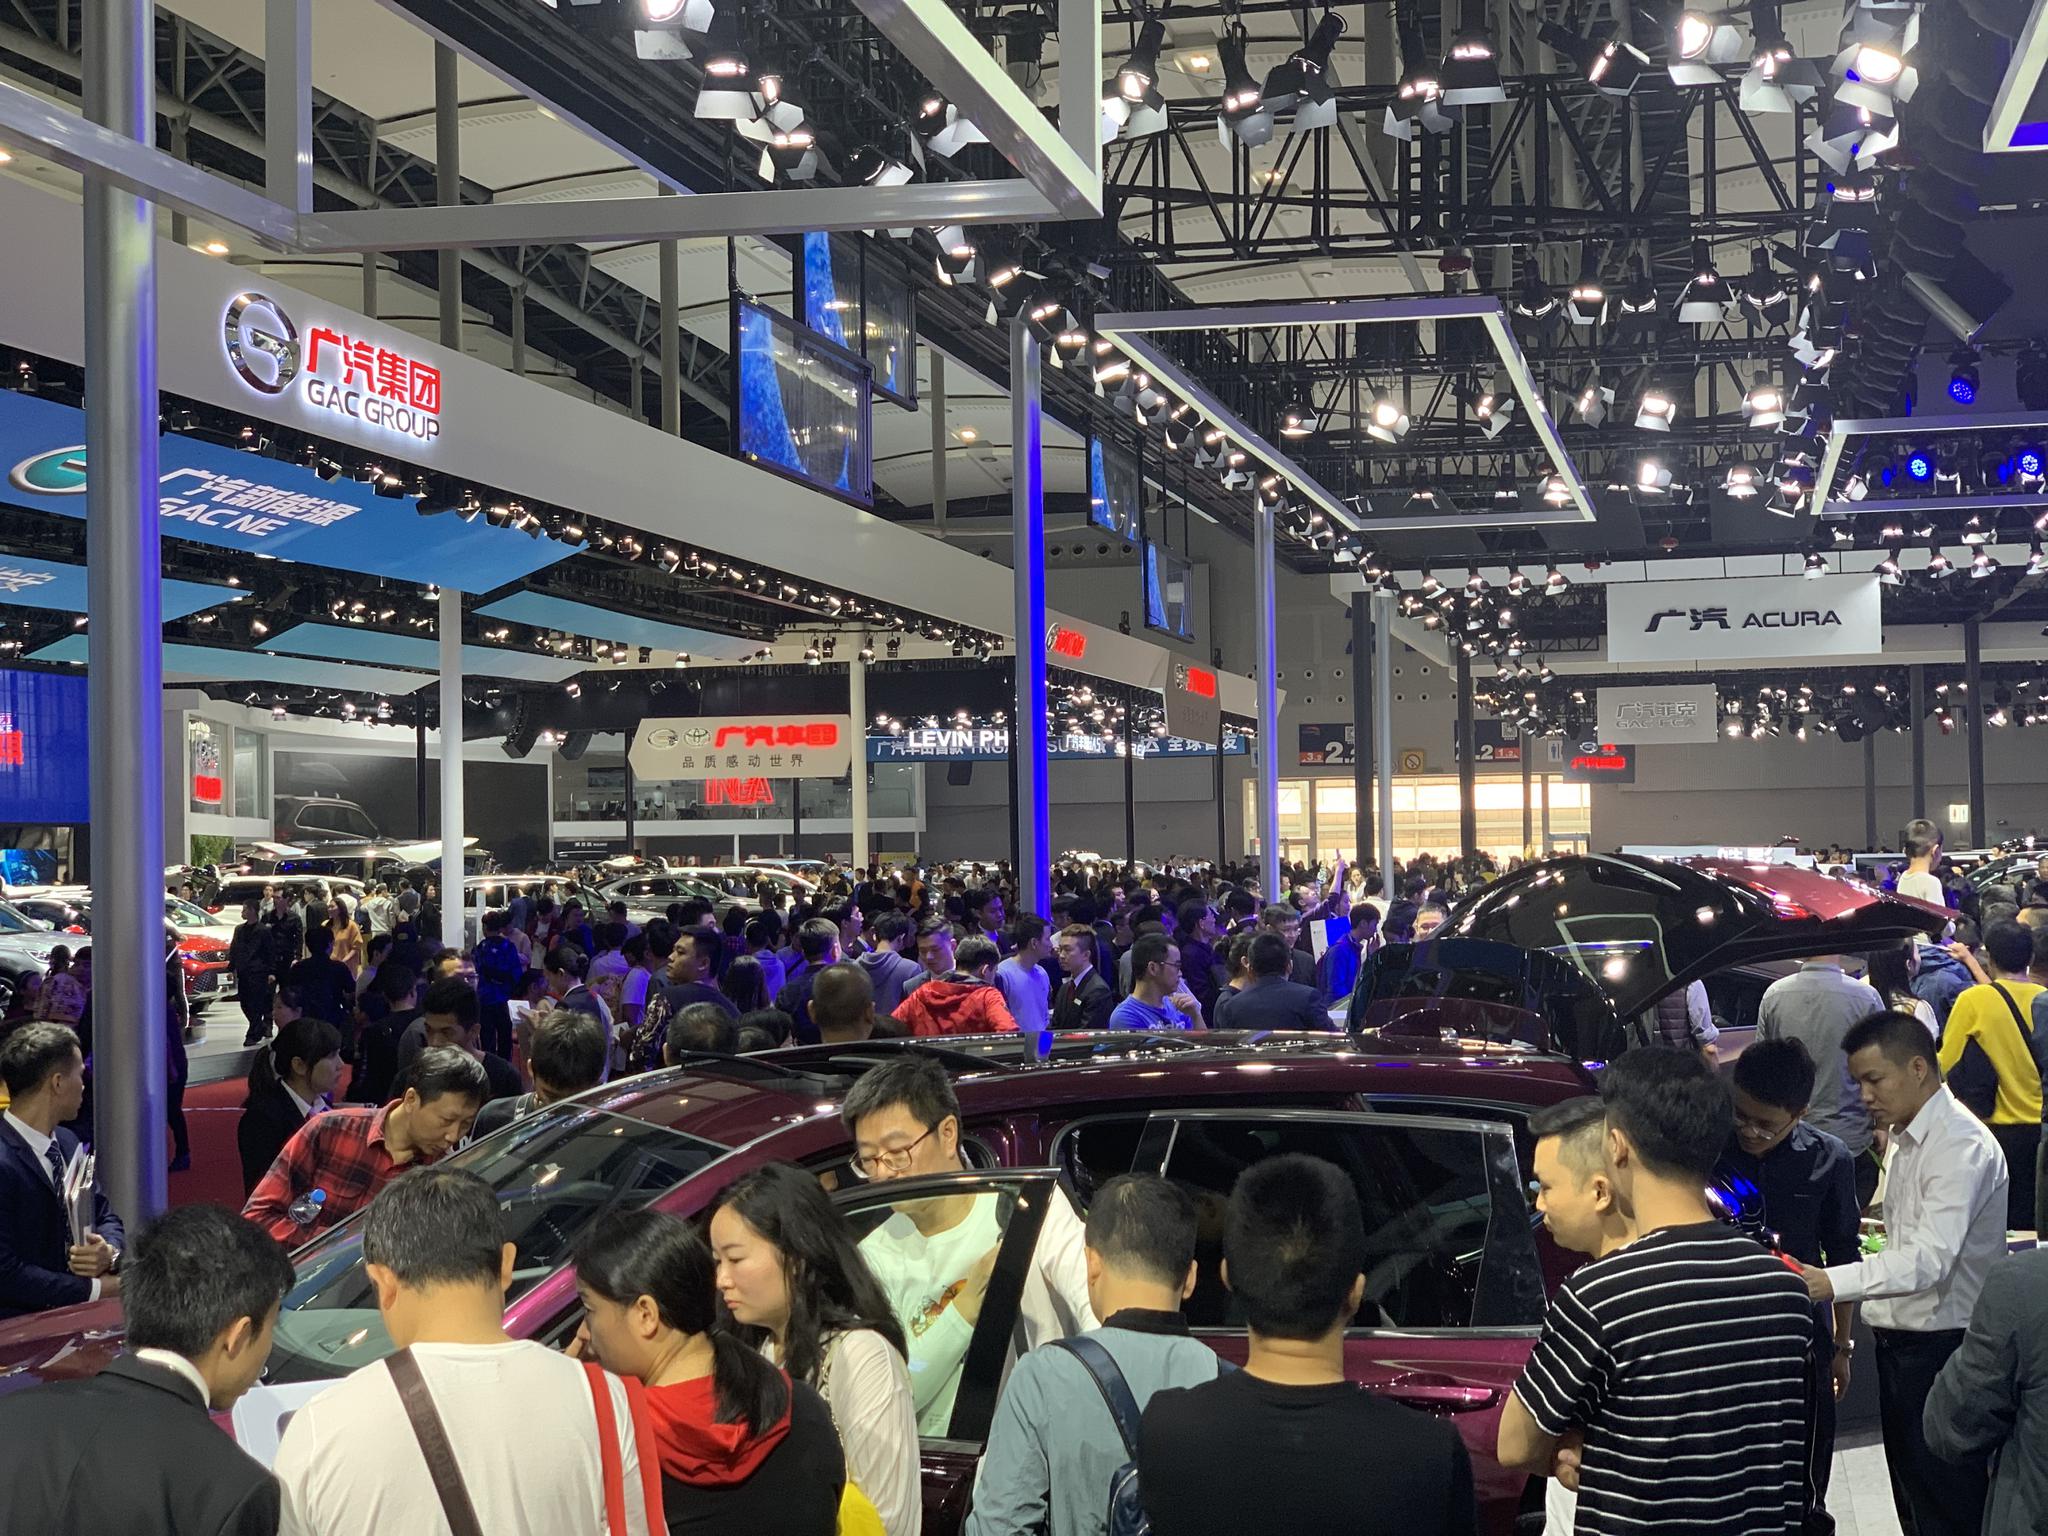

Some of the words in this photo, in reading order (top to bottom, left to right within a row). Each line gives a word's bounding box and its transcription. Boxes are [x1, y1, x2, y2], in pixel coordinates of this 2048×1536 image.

[306, 327, 442, 415] 广汽集团
[307, 379, 360, 418] GAC
[363, 399, 441, 442] GROUP
[159, 467, 362, 527] 广汽新能源
[159, 497, 241, 526] GAC
[223, 513, 290, 537] NE
[1644, 606, 1731, 633] 广汽
[1741, 609, 1843, 629] ACURA
[1616, 701, 1698, 719] 广汽菲克
[909, 730, 973, 748] LEVIN
[979, 730, 1009, 748] PH
[1325, 741, 1355, 764] 2.
[682, 753, 805, 769] 品质感动世界
